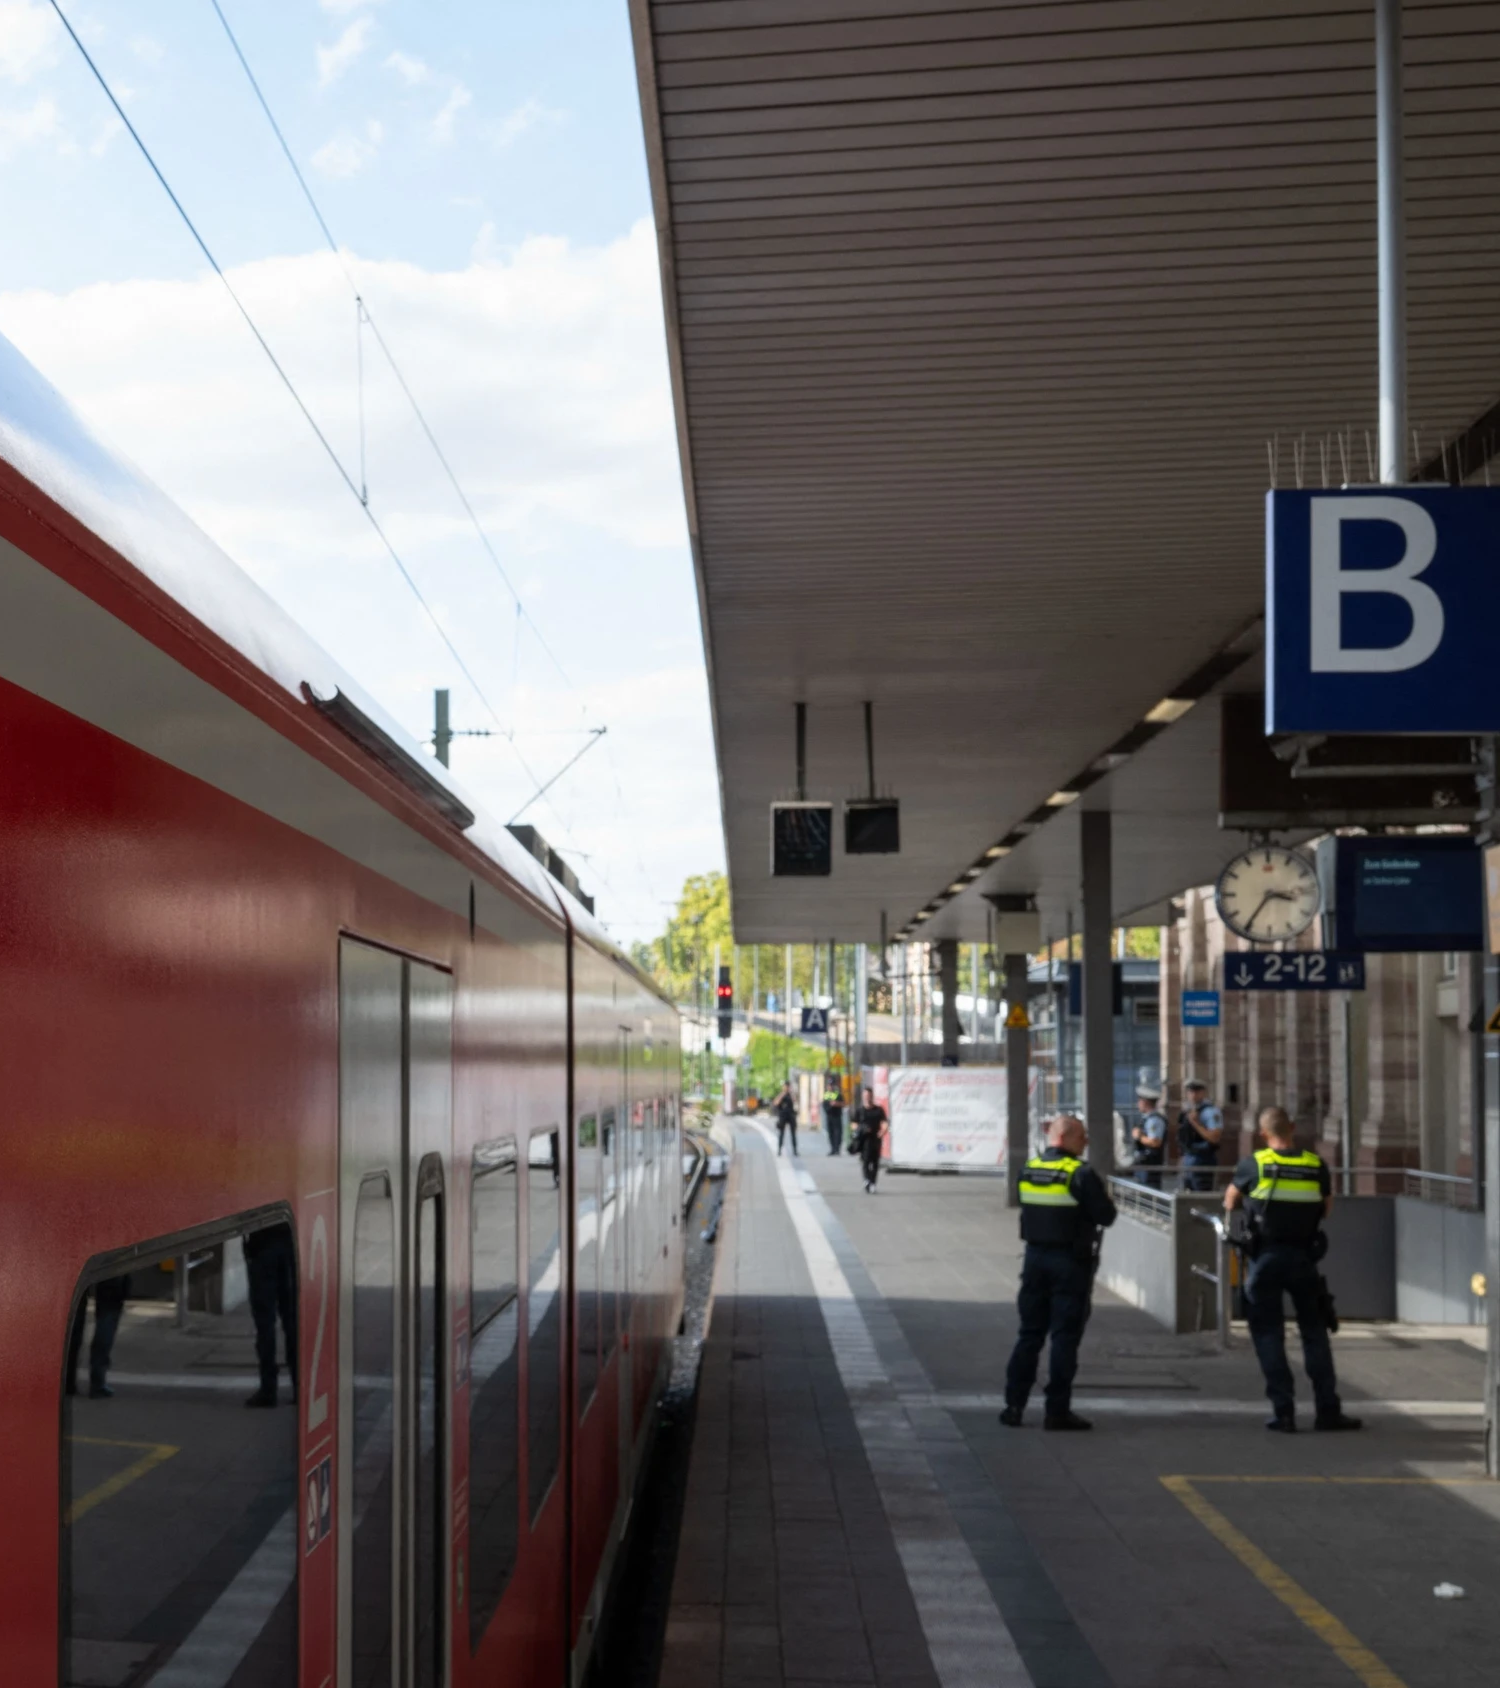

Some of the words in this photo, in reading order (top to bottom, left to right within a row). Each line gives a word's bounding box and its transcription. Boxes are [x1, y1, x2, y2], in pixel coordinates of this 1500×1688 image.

[1310, 496, 1445, 673] B
[805, 1008, 825, 1029] A
[1264, 954, 1326, 982] 2-12
[308, 1213, 329, 1434] 2
